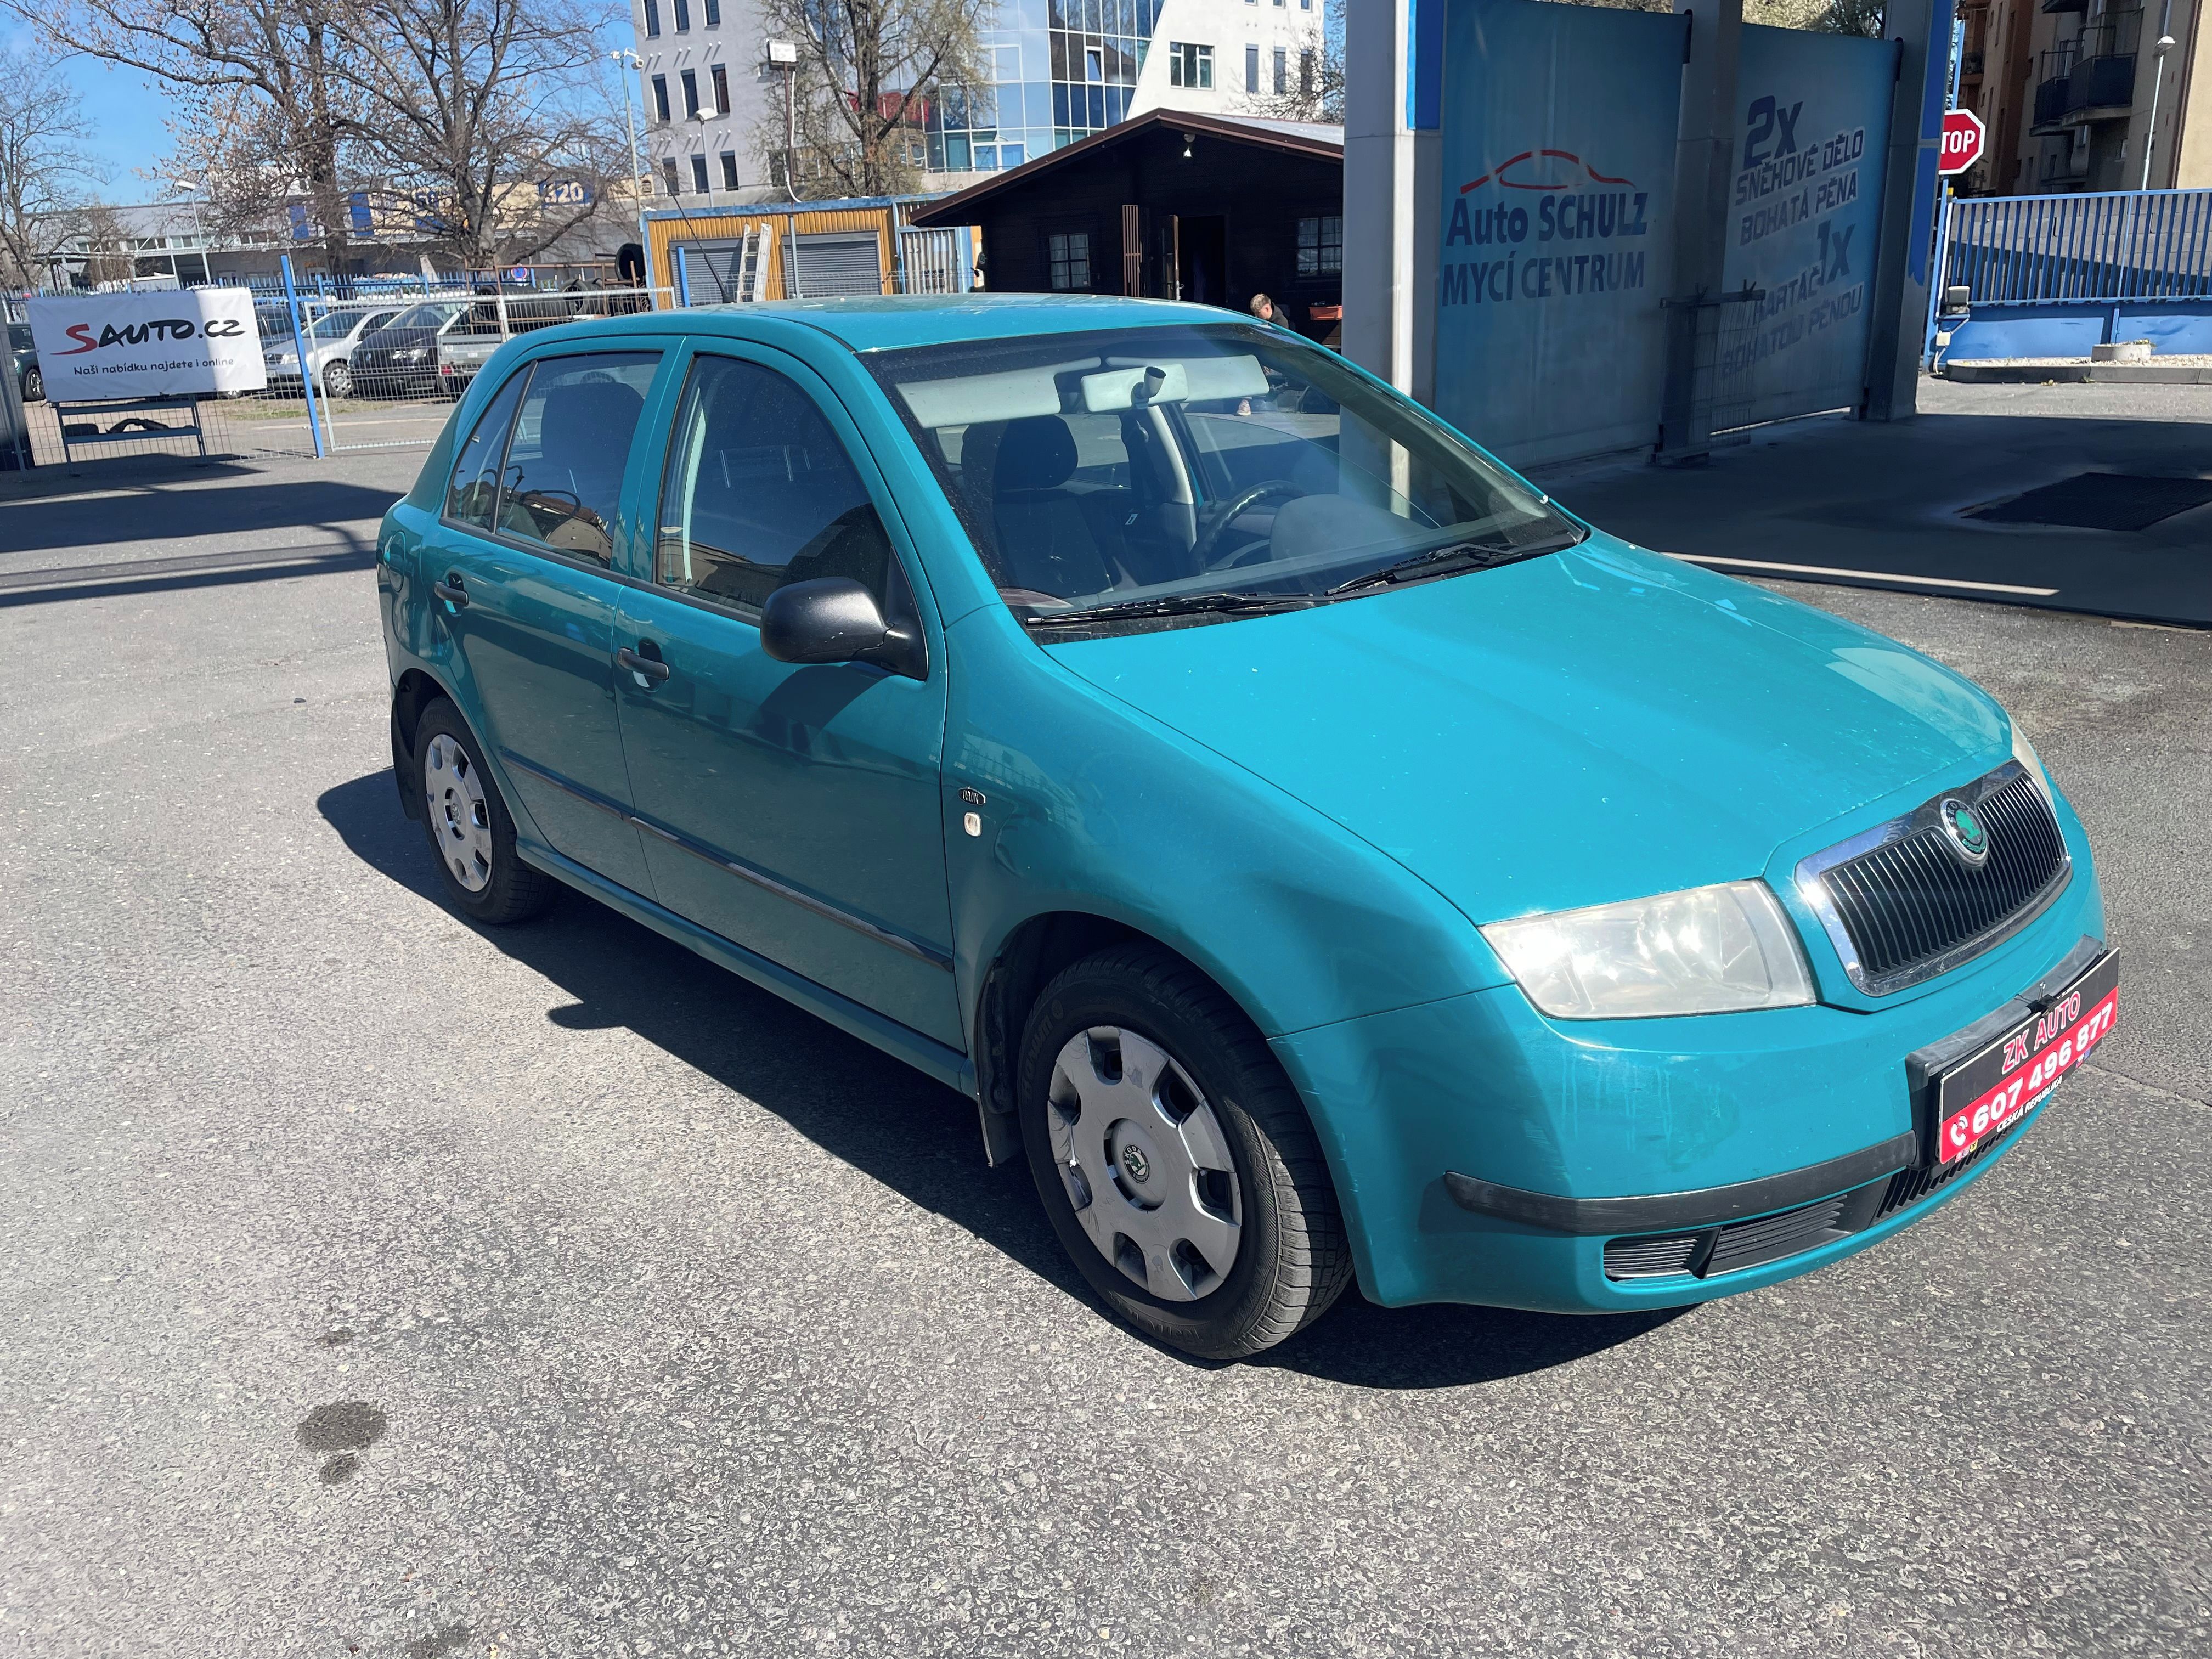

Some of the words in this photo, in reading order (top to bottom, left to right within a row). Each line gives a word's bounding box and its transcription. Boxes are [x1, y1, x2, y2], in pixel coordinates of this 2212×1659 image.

[1941, 130, 1976, 154] TOP
[1446, 198, 1528, 246] Auto
[1538, 193, 1648, 242] SCHULZ
[1442, 251, 1517, 307] MYCÍ
[1521, 251, 1645, 298] CENTRUM
[74, 365, 98, 375] Naši
[102, 363, 148, 374] nabídku
[150, 360, 193, 373] najdete
[196, 359, 199, 367] i
[202, 357, 234, 368] online
[2002, 1028, 2030, 1075] ZK
[2034, 991, 2081, 1052] AUTO
[1972, 1077, 2023, 1134] 607
[2028, 1039, 2072, 1091] 496
[2076, 1001, 2113, 1052] 877
[2024, 1075, 2063, 1113] REPUBLIKA
